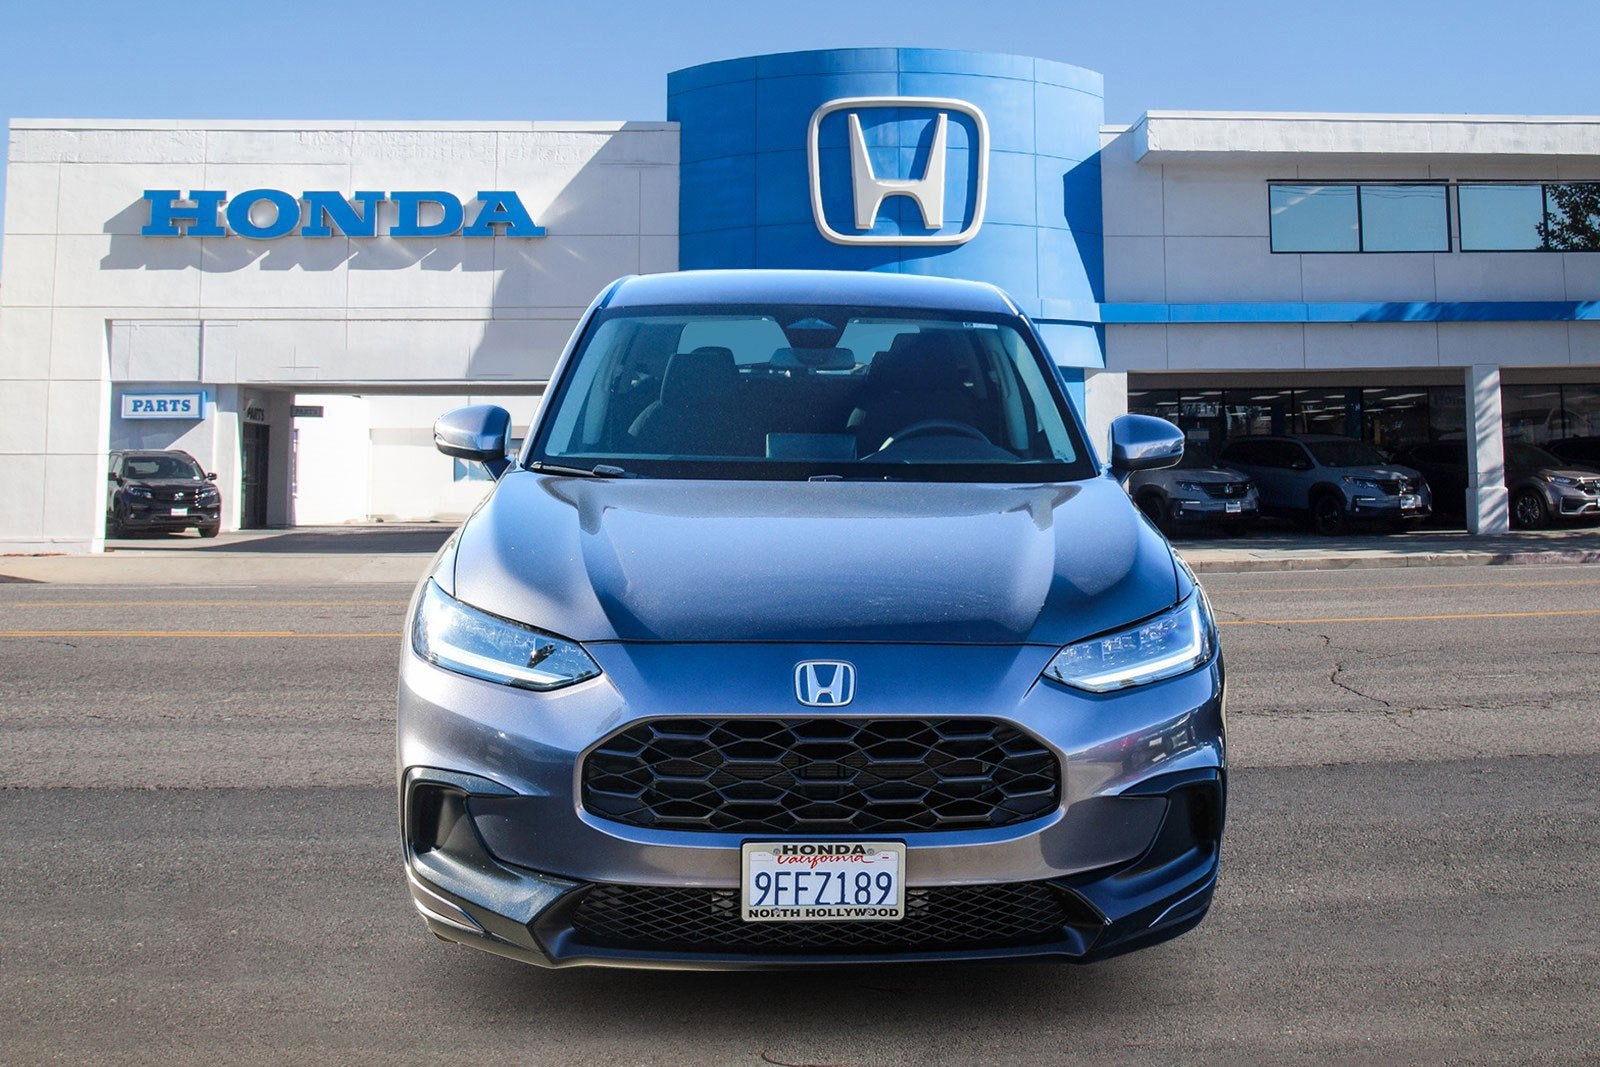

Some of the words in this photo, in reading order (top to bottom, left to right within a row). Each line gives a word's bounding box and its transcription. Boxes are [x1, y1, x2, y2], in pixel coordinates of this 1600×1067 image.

[141, 188, 548, 239] HONDA
[131, 399, 191, 412] PARTS
[782, 844, 867, 855] HONDA
[754, 871, 893, 906] 9FFZ189
[805, 908, 899, 918] HOLLYWOOD
